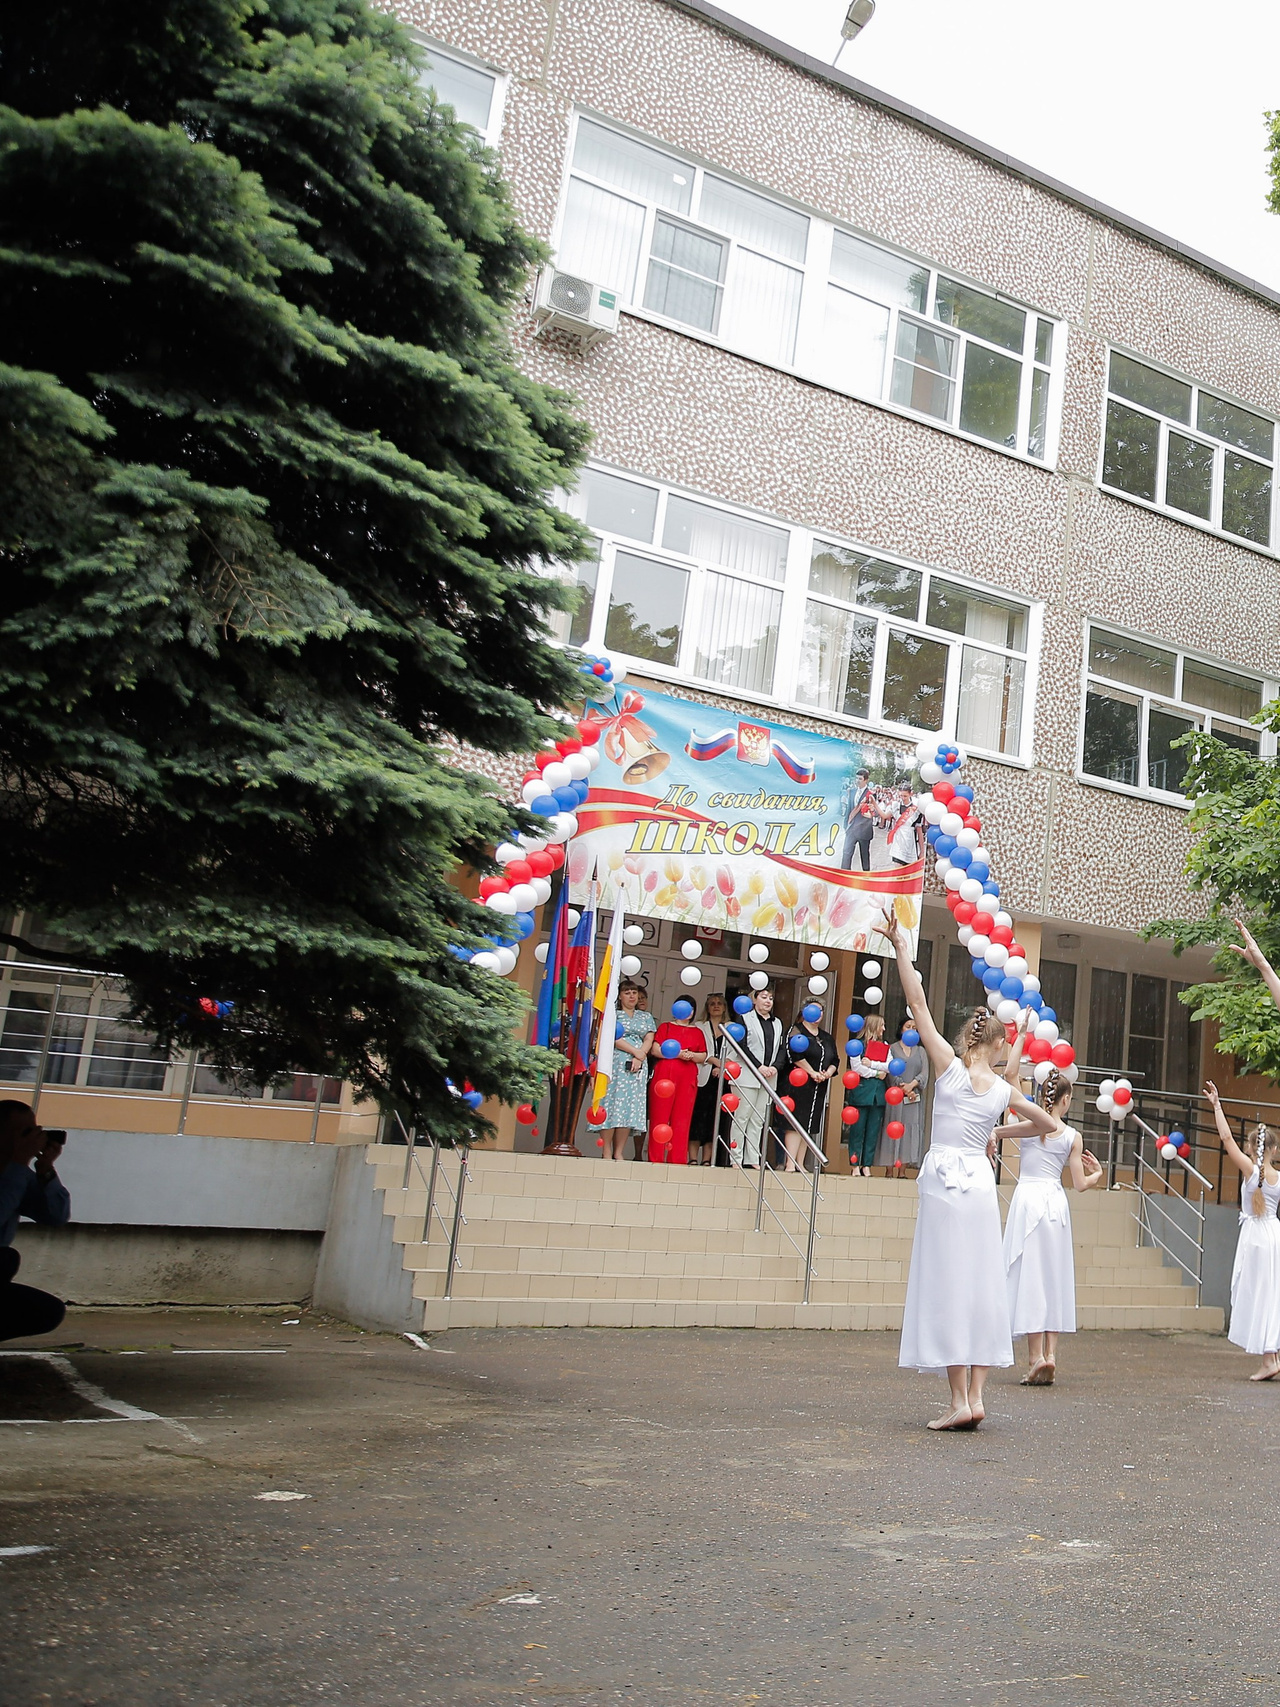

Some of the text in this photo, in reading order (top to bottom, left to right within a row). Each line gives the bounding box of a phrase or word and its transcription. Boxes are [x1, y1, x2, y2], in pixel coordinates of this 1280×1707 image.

[653, 783, 829, 816] До свидания,
[624, 818, 841, 857] ШКОЛА!
